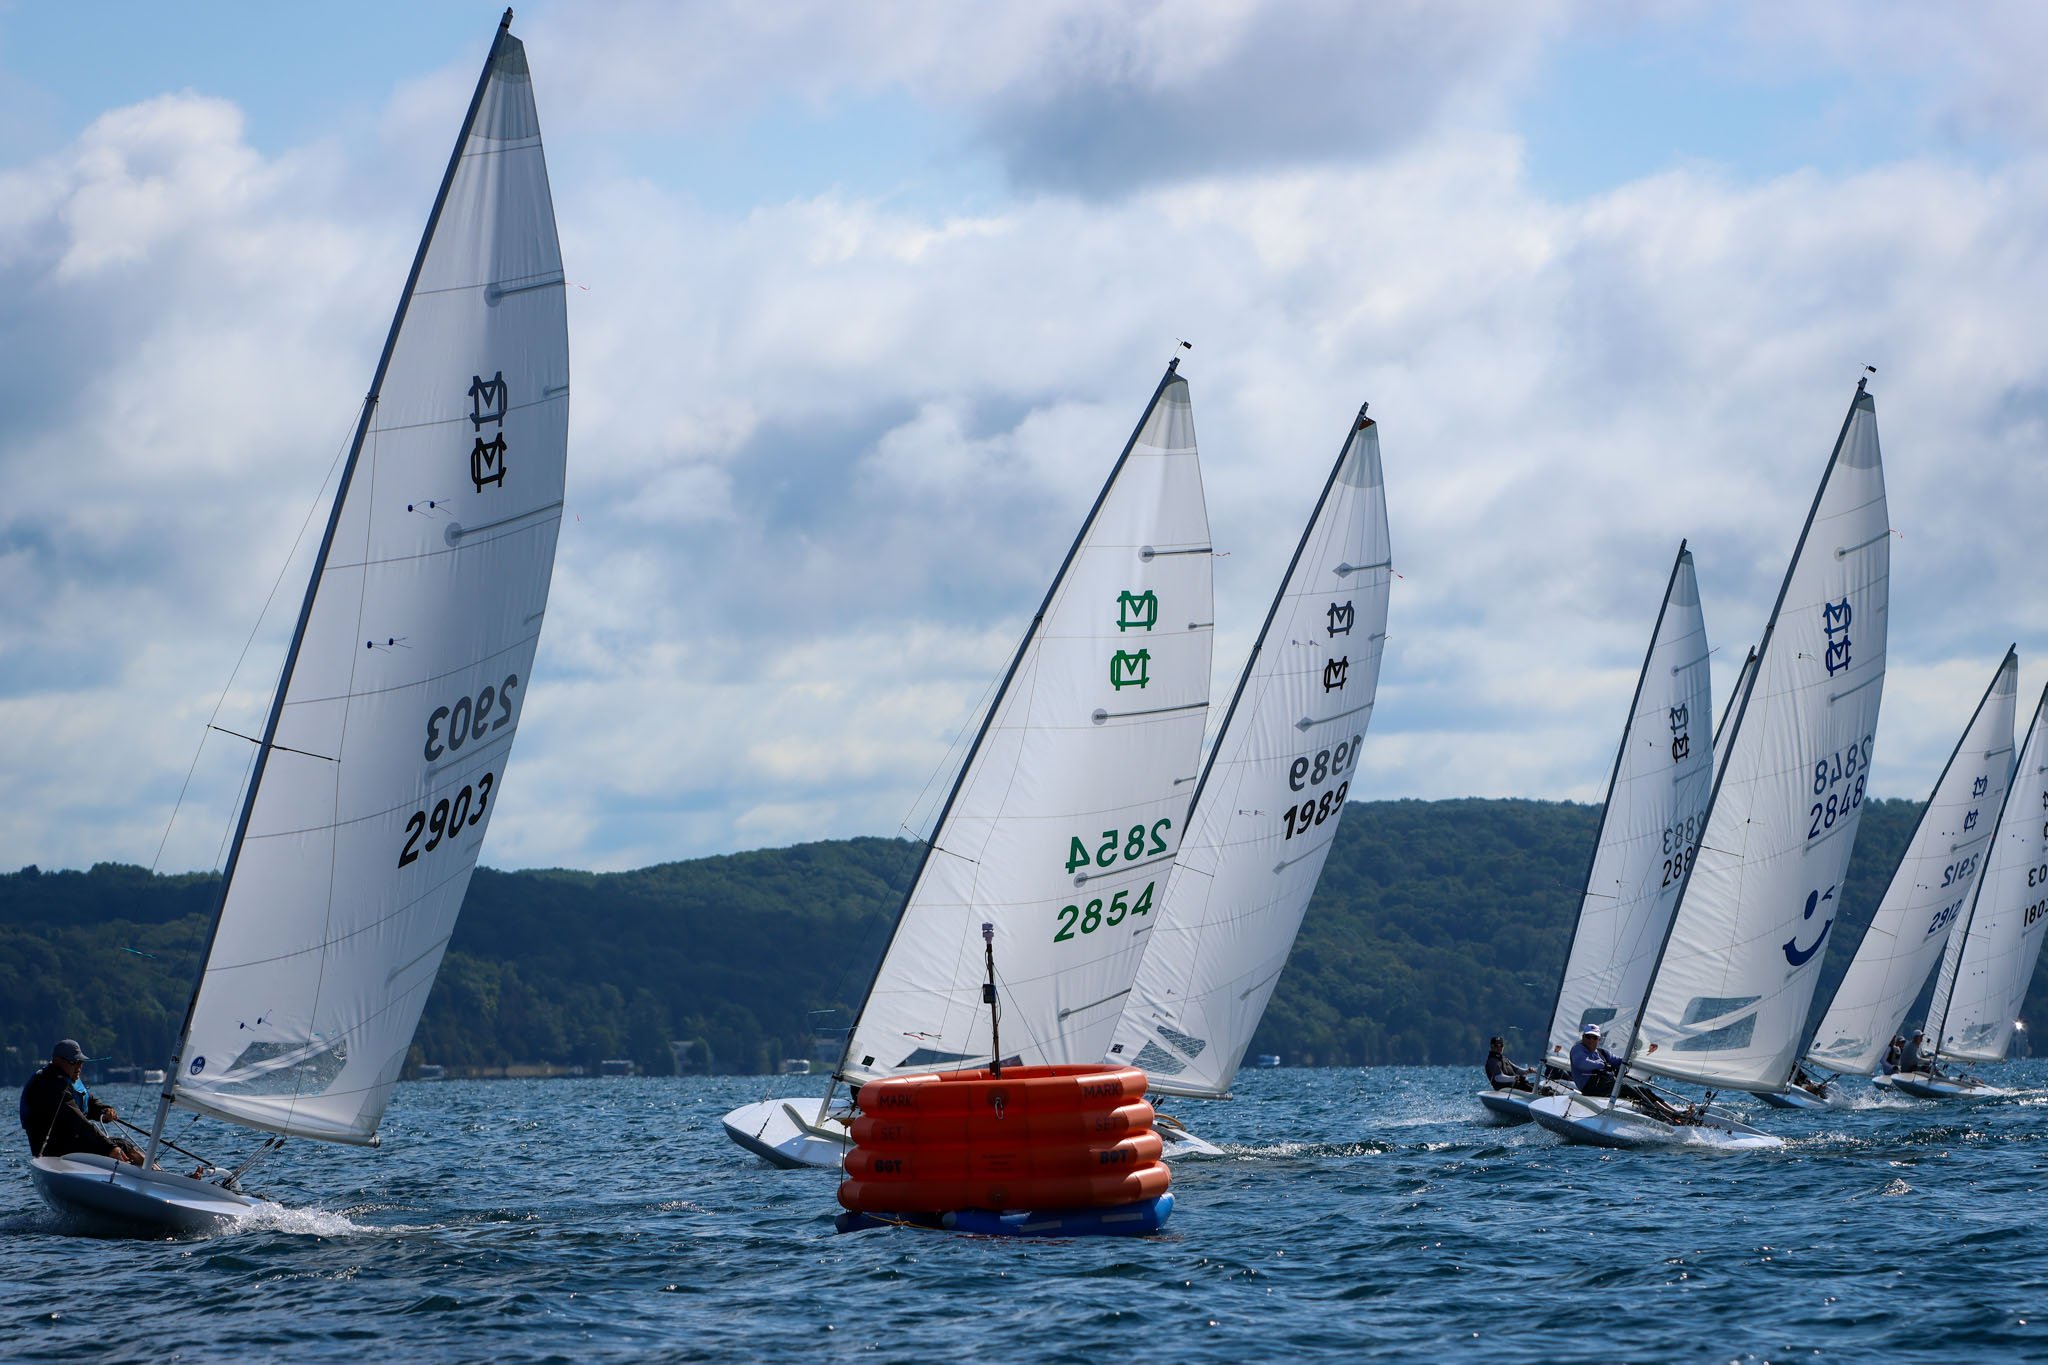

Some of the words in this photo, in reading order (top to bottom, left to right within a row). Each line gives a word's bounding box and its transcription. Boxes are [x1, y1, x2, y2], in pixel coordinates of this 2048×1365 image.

[398, 772, 494, 869] 2903
[1283, 781, 1349, 840] 1989
[1808, 774, 1865, 840] 2848
[1662, 846, 1693, 888] 288
[1053, 882, 1155, 942] 2854
[1928, 899, 1963, 935] 2912
[2024, 898, 2048, 927] 180
[879, 1094, 913, 1108] MARK
[1083, 1084, 1120, 1098] MARK
[880, 1126, 904, 1142] SET
[1096, 1117, 1121, 1132] SET
